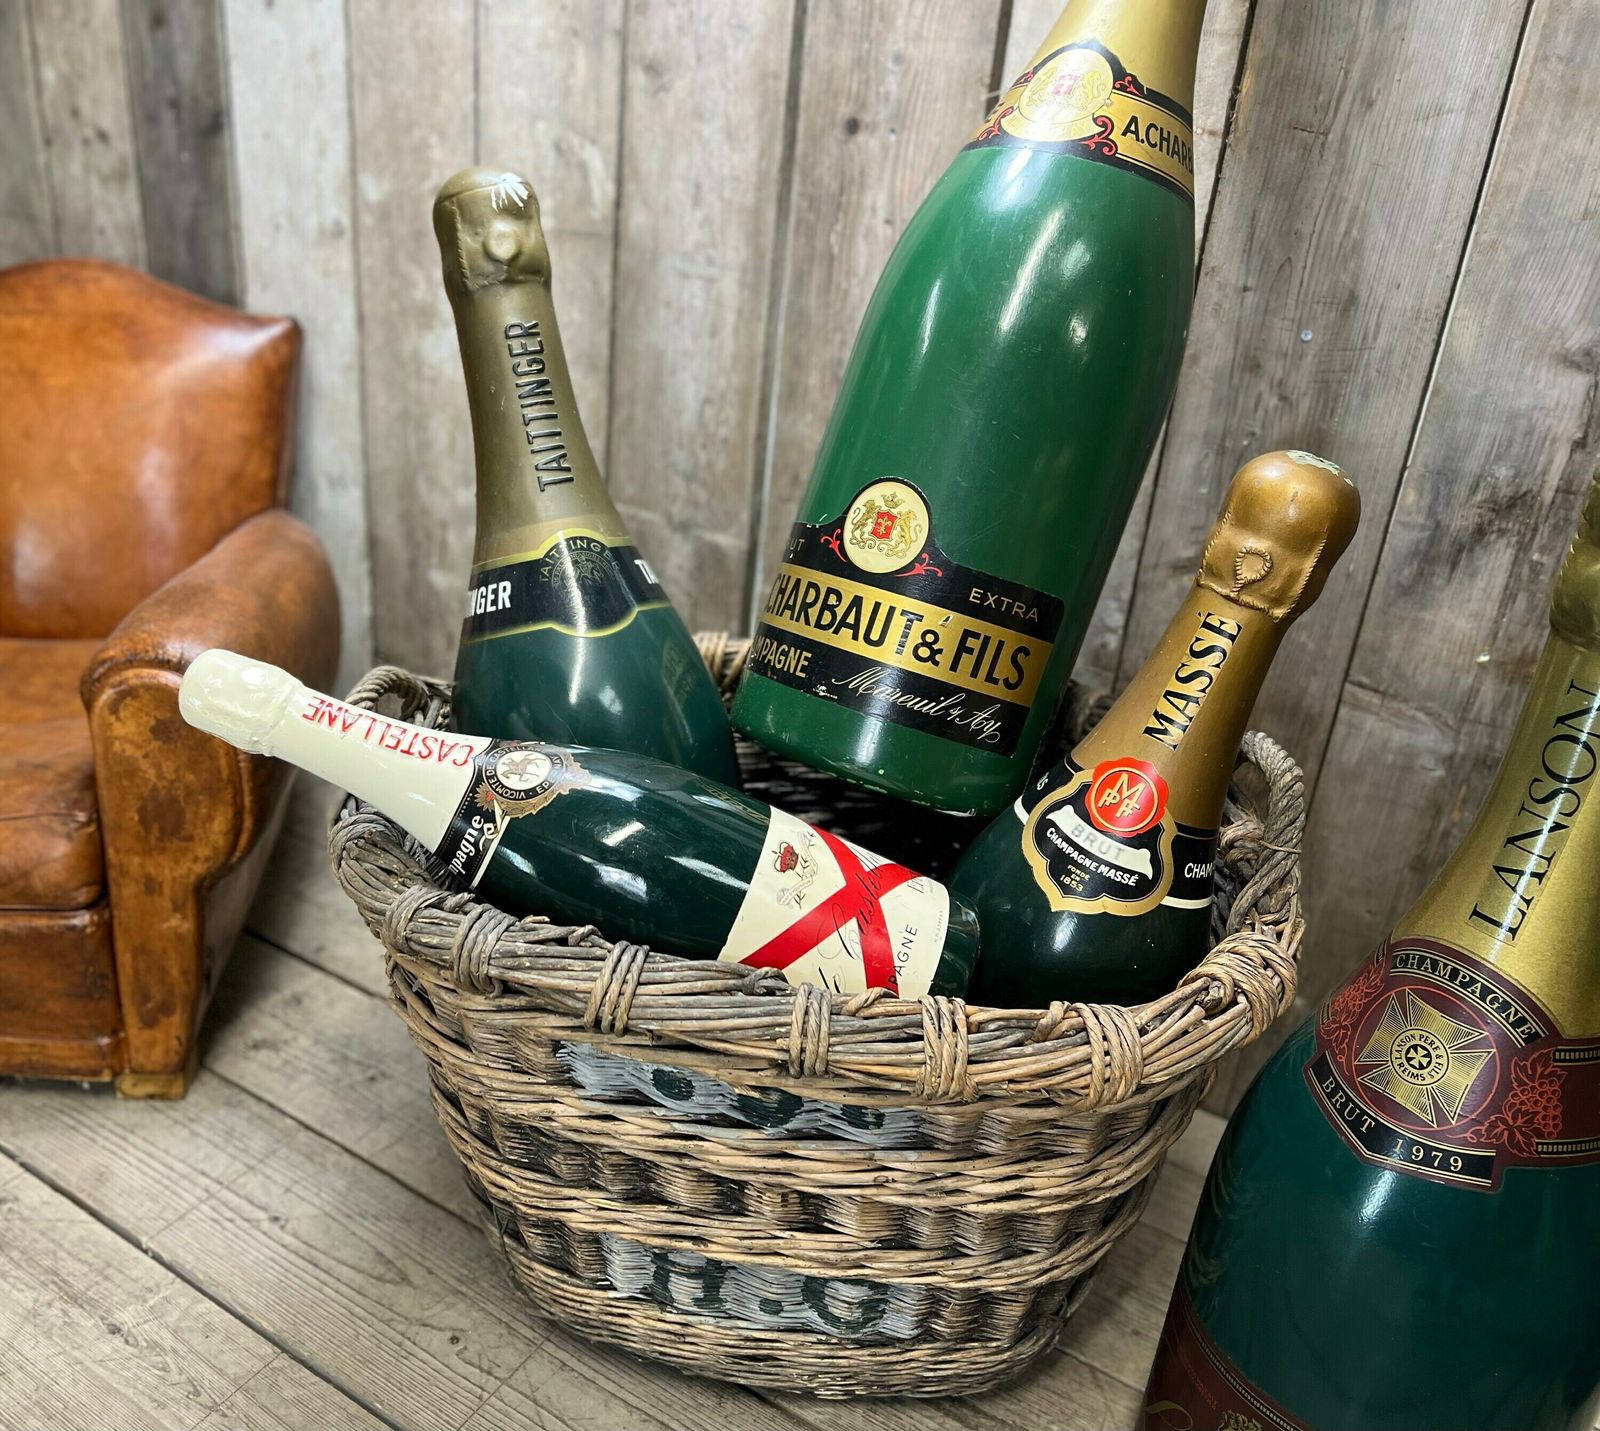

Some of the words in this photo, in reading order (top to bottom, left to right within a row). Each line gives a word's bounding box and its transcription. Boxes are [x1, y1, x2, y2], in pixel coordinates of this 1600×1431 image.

[504, 319, 575, 492] TAITTINGER
[539, 539, 621, 584] TAITINGER
[968, 587, 1039, 623] EXTRA
[911, 628, 944, 668] &
[949, 627, 1032, 691] FILS
[1142, 610, 1243, 751] MASSÉ
[302, 695, 475, 767] CASTELLANE
[488, 777, 527, 800] VICOMTE
[1468, 678, 1600, 941] LANSON
[1046, 827, 1098, 872] CHAMPAGNE
[1097, 863, 1139, 886] MASSÉ
[1071, 823, 1125, 860] BRUT
[1060, 874, 1084, 892] 1853
[1067, 864, 1091, 881] FONDÉ
[1396, 954, 1536, 1039] CHAMPAGNE
[1395, 1033, 1417, 1060] LANSON
[1427, 1061, 1444, 1079] FILS
[1397, 1062, 1425, 1081] REIMS
[1322, 1077, 1375, 1134] BRUT
[1393, 1139, 1463, 1172] 1979
